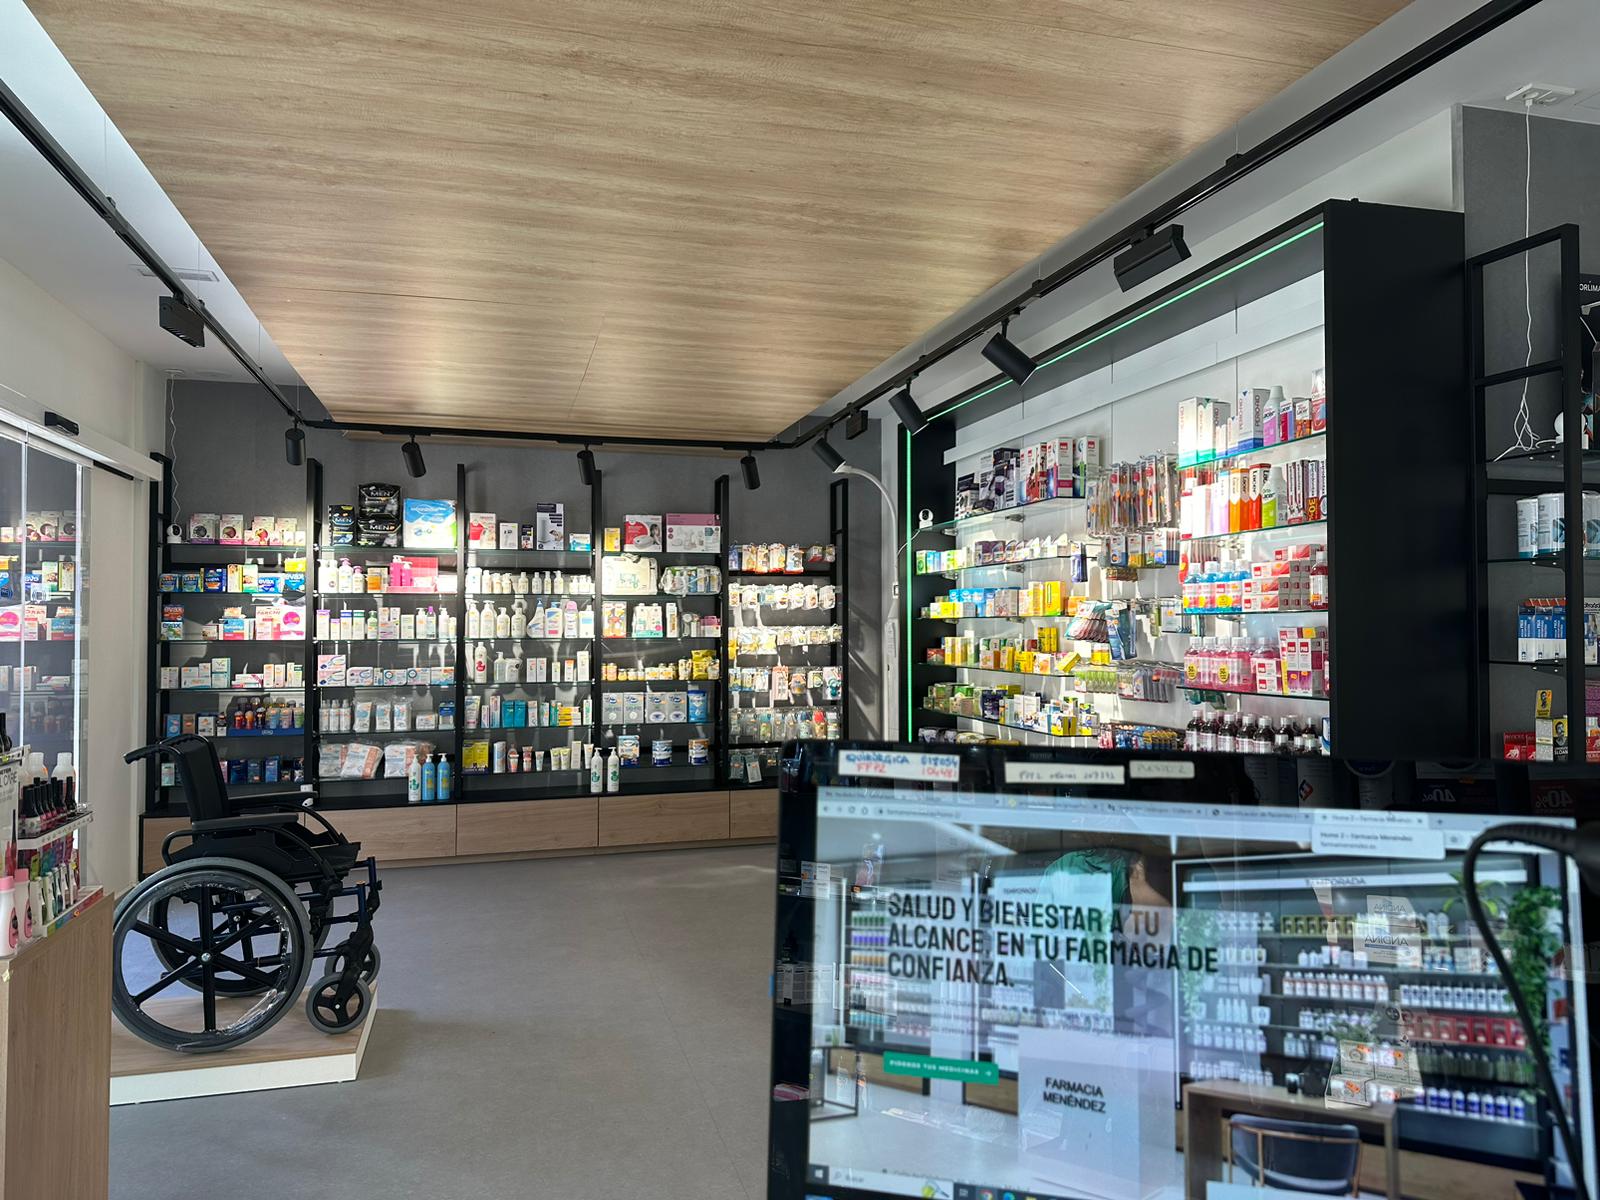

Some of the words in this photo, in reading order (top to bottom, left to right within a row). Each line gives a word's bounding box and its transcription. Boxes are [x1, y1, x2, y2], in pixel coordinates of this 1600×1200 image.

[887, 892, 956, 921] SALUD
[961, 896, 974, 921] Y
[979, 899, 1103, 932] BIENESTAR
[1110, 910, 1124, 934] A
[1131, 910, 1160, 936] TU
[887, 923, 989, 955] ALCANCE,
[996, 930, 1024, 957] EN
[1030, 933, 1059, 961] TU
[1066, 936, 1182, 971] FARMACIA
[1188, 945, 1219, 973] DE
[887, 953, 1015, 988] CONFIANZA.
[923, 1062, 937, 1071] TUS
[938, 1064, 980, 1076] MEDICINAS
[1045, 1077, 1104, 1098] FARMACIA
[1043, 1091, 1106, 1115] MENÉNDEZ
